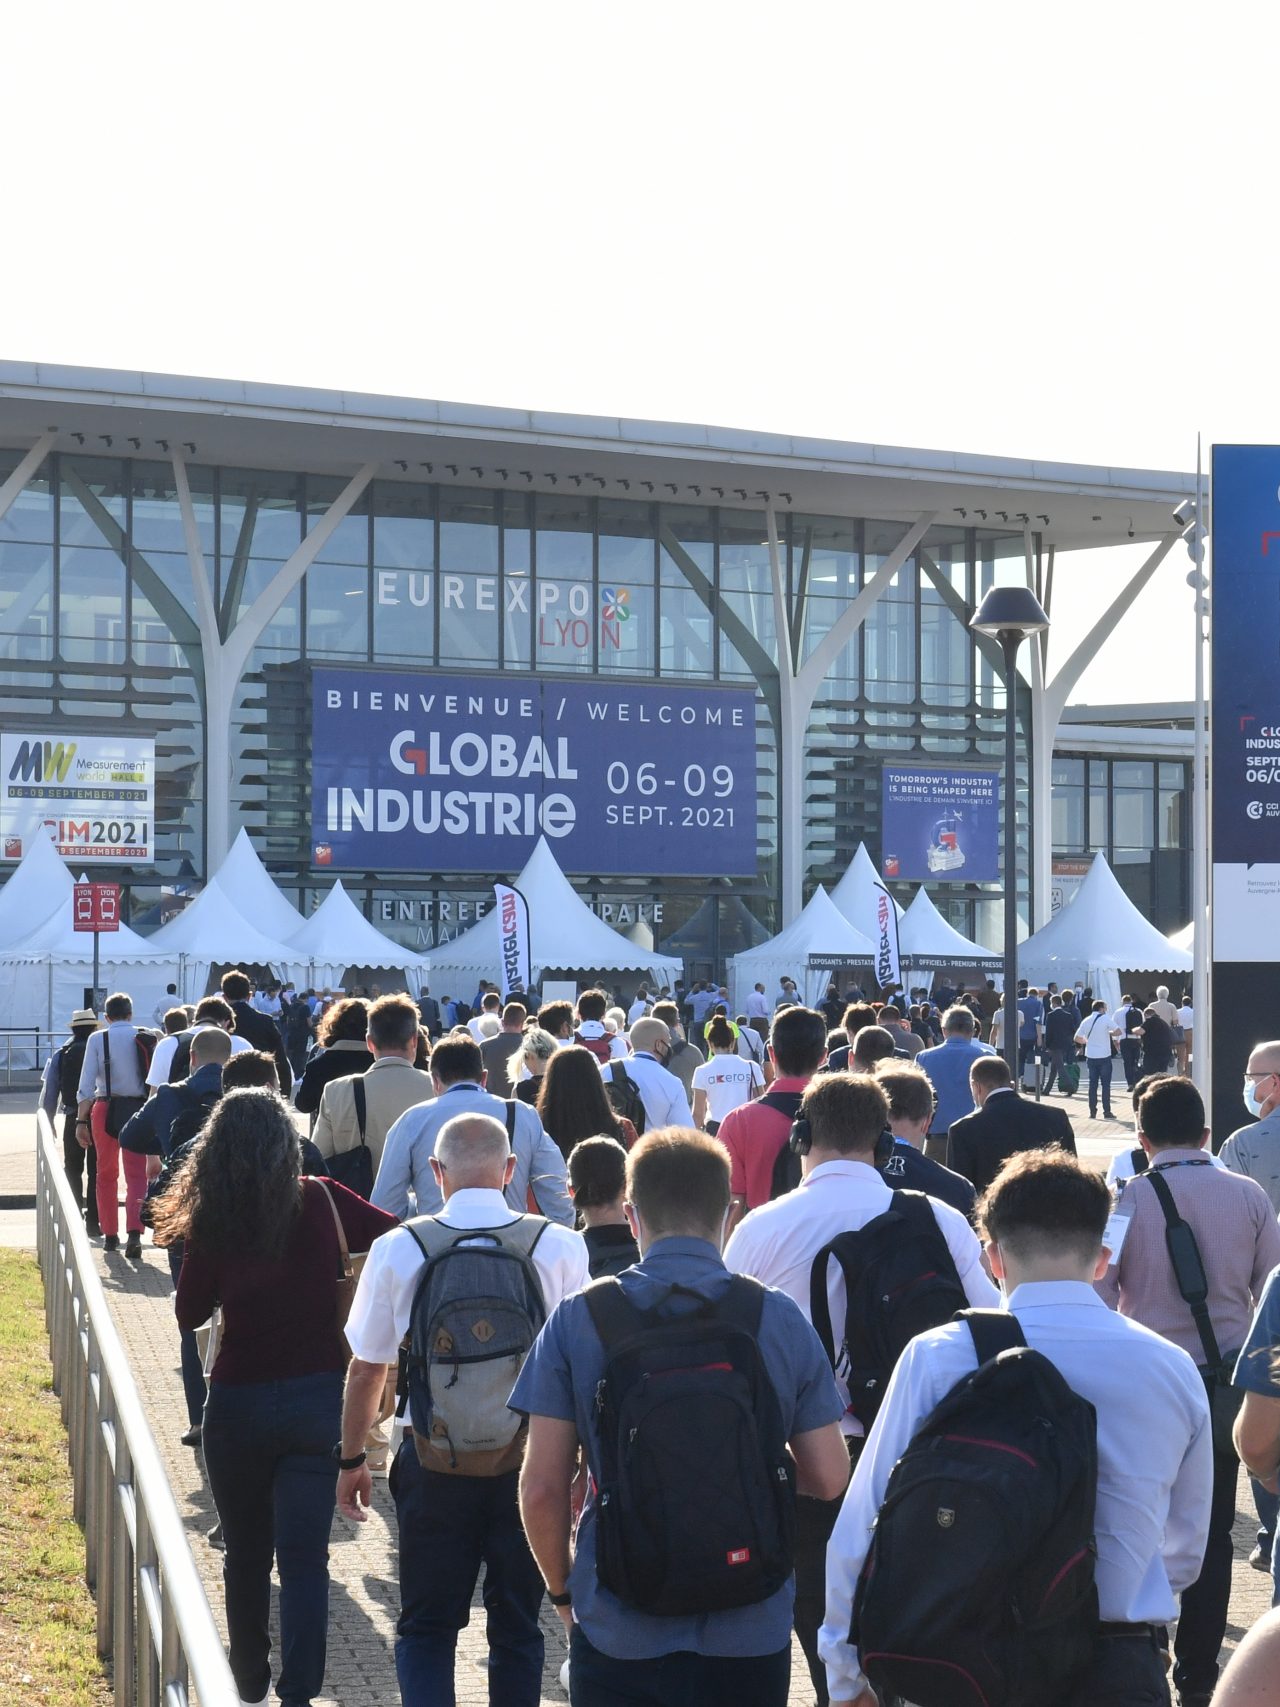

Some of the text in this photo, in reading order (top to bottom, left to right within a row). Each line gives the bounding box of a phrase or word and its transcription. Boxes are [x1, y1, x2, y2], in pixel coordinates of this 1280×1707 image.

[378, 571, 590, 617] EUREXPO
[538, 618, 621, 650] LYON
[326, 689, 534, 718] BIENVENUE
[587, 702, 745, 727] WELCOME
[389, 729, 578, 780] GLOBAL
[76, 758, 147, 771] Measurement
[606, 760, 735, 798] 06-09
[889, 774, 993, 787] TOMORROW'S INDUSTRY
[9, 787, 146, 800] 06-09 SEPTEMBER 2021
[889, 785, 993, 797] IS BEING SHAPED HERE
[606, 804, 736, 829] SEPT. 2021
[69, 847, 122, 856] SEPTEMBER
[124, 848, 146, 857] 2021
[77, 889, 92, 897] LYON
[100, 889, 116, 897] LYON
[382, 900, 486, 921] ENTREE
[416, 926, 469, 945] MAI
[810, 958, 843, 967] EXPOSANTS
[846, 959, 876, 967] PRESTATA
[919, 958, 947, 968] OFFICIELS
[951, 961, 977, 969] PREMIUM
[981, 961, 1004, 969] PRESSE
